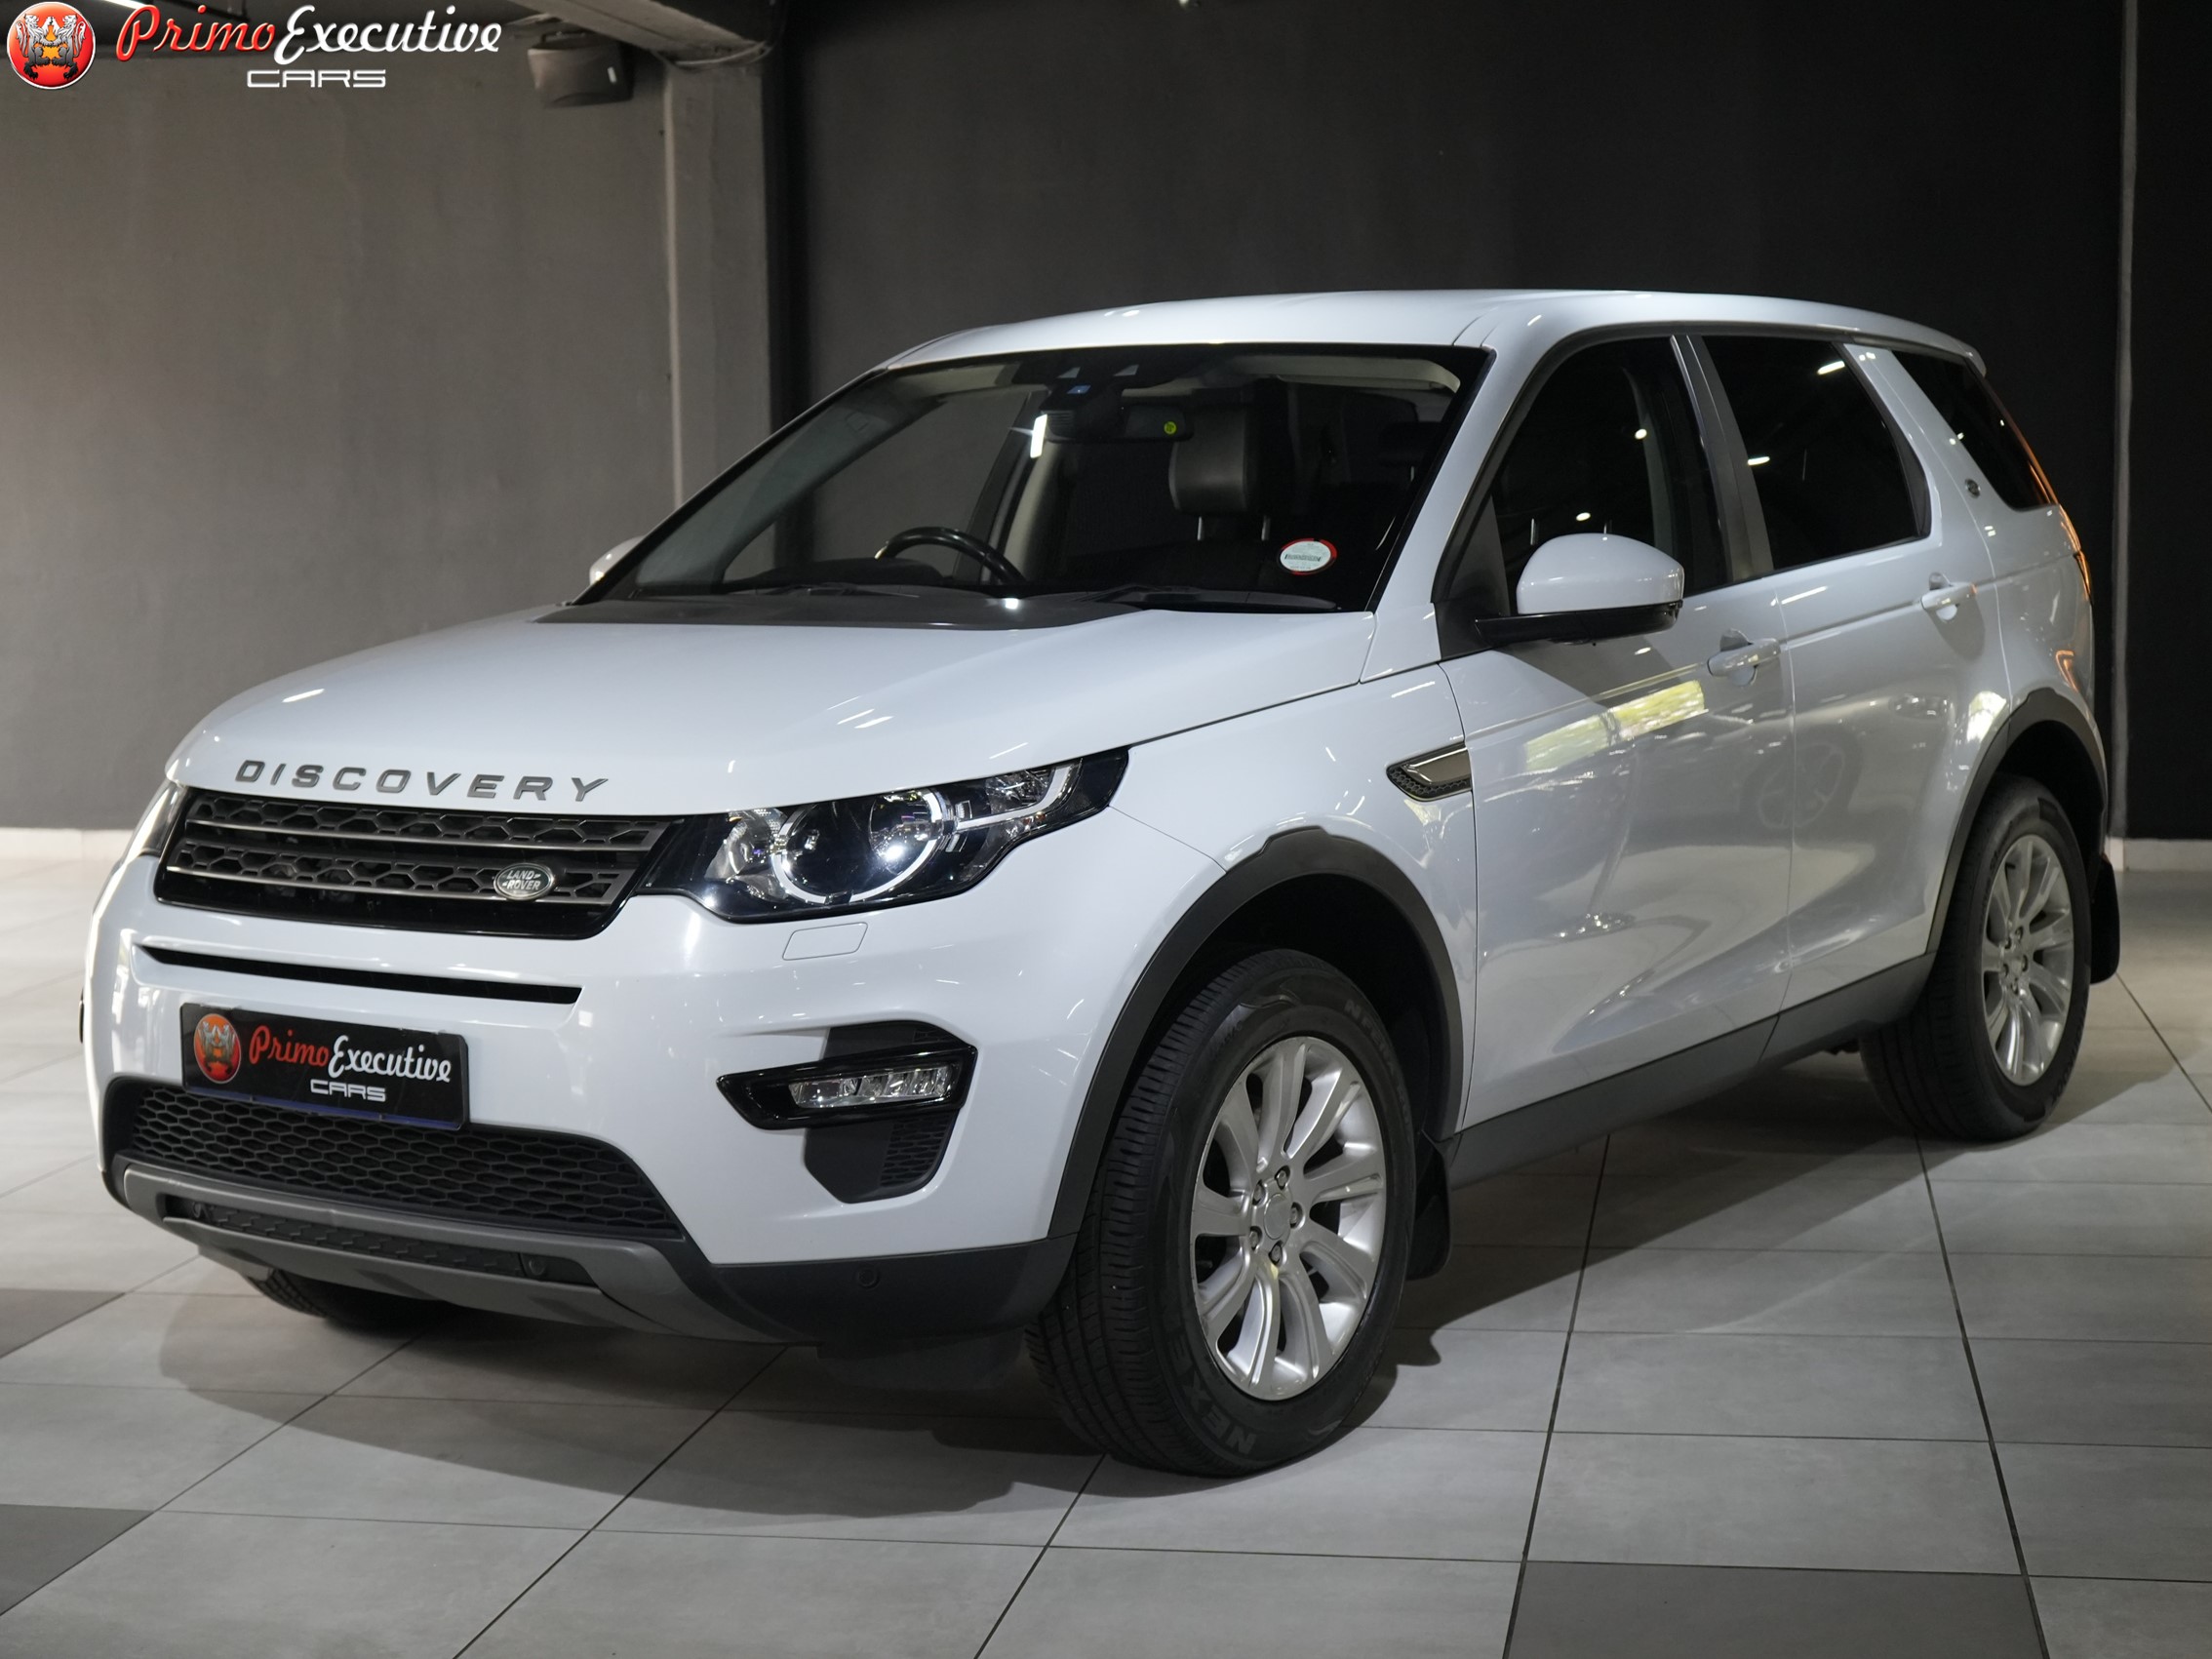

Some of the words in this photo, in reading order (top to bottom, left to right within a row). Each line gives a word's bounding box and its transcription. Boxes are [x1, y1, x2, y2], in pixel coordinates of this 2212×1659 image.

[235, 760, 609, 802] DISCOVERY
[504, 879, 541, 890] ROVER
[506, 870, 538, 880] LAND
[249, 1025, 330, 1067] Primo
[329, 1035, 452, 1083] Executive
[310, 1079, 386, 1102] CARS
